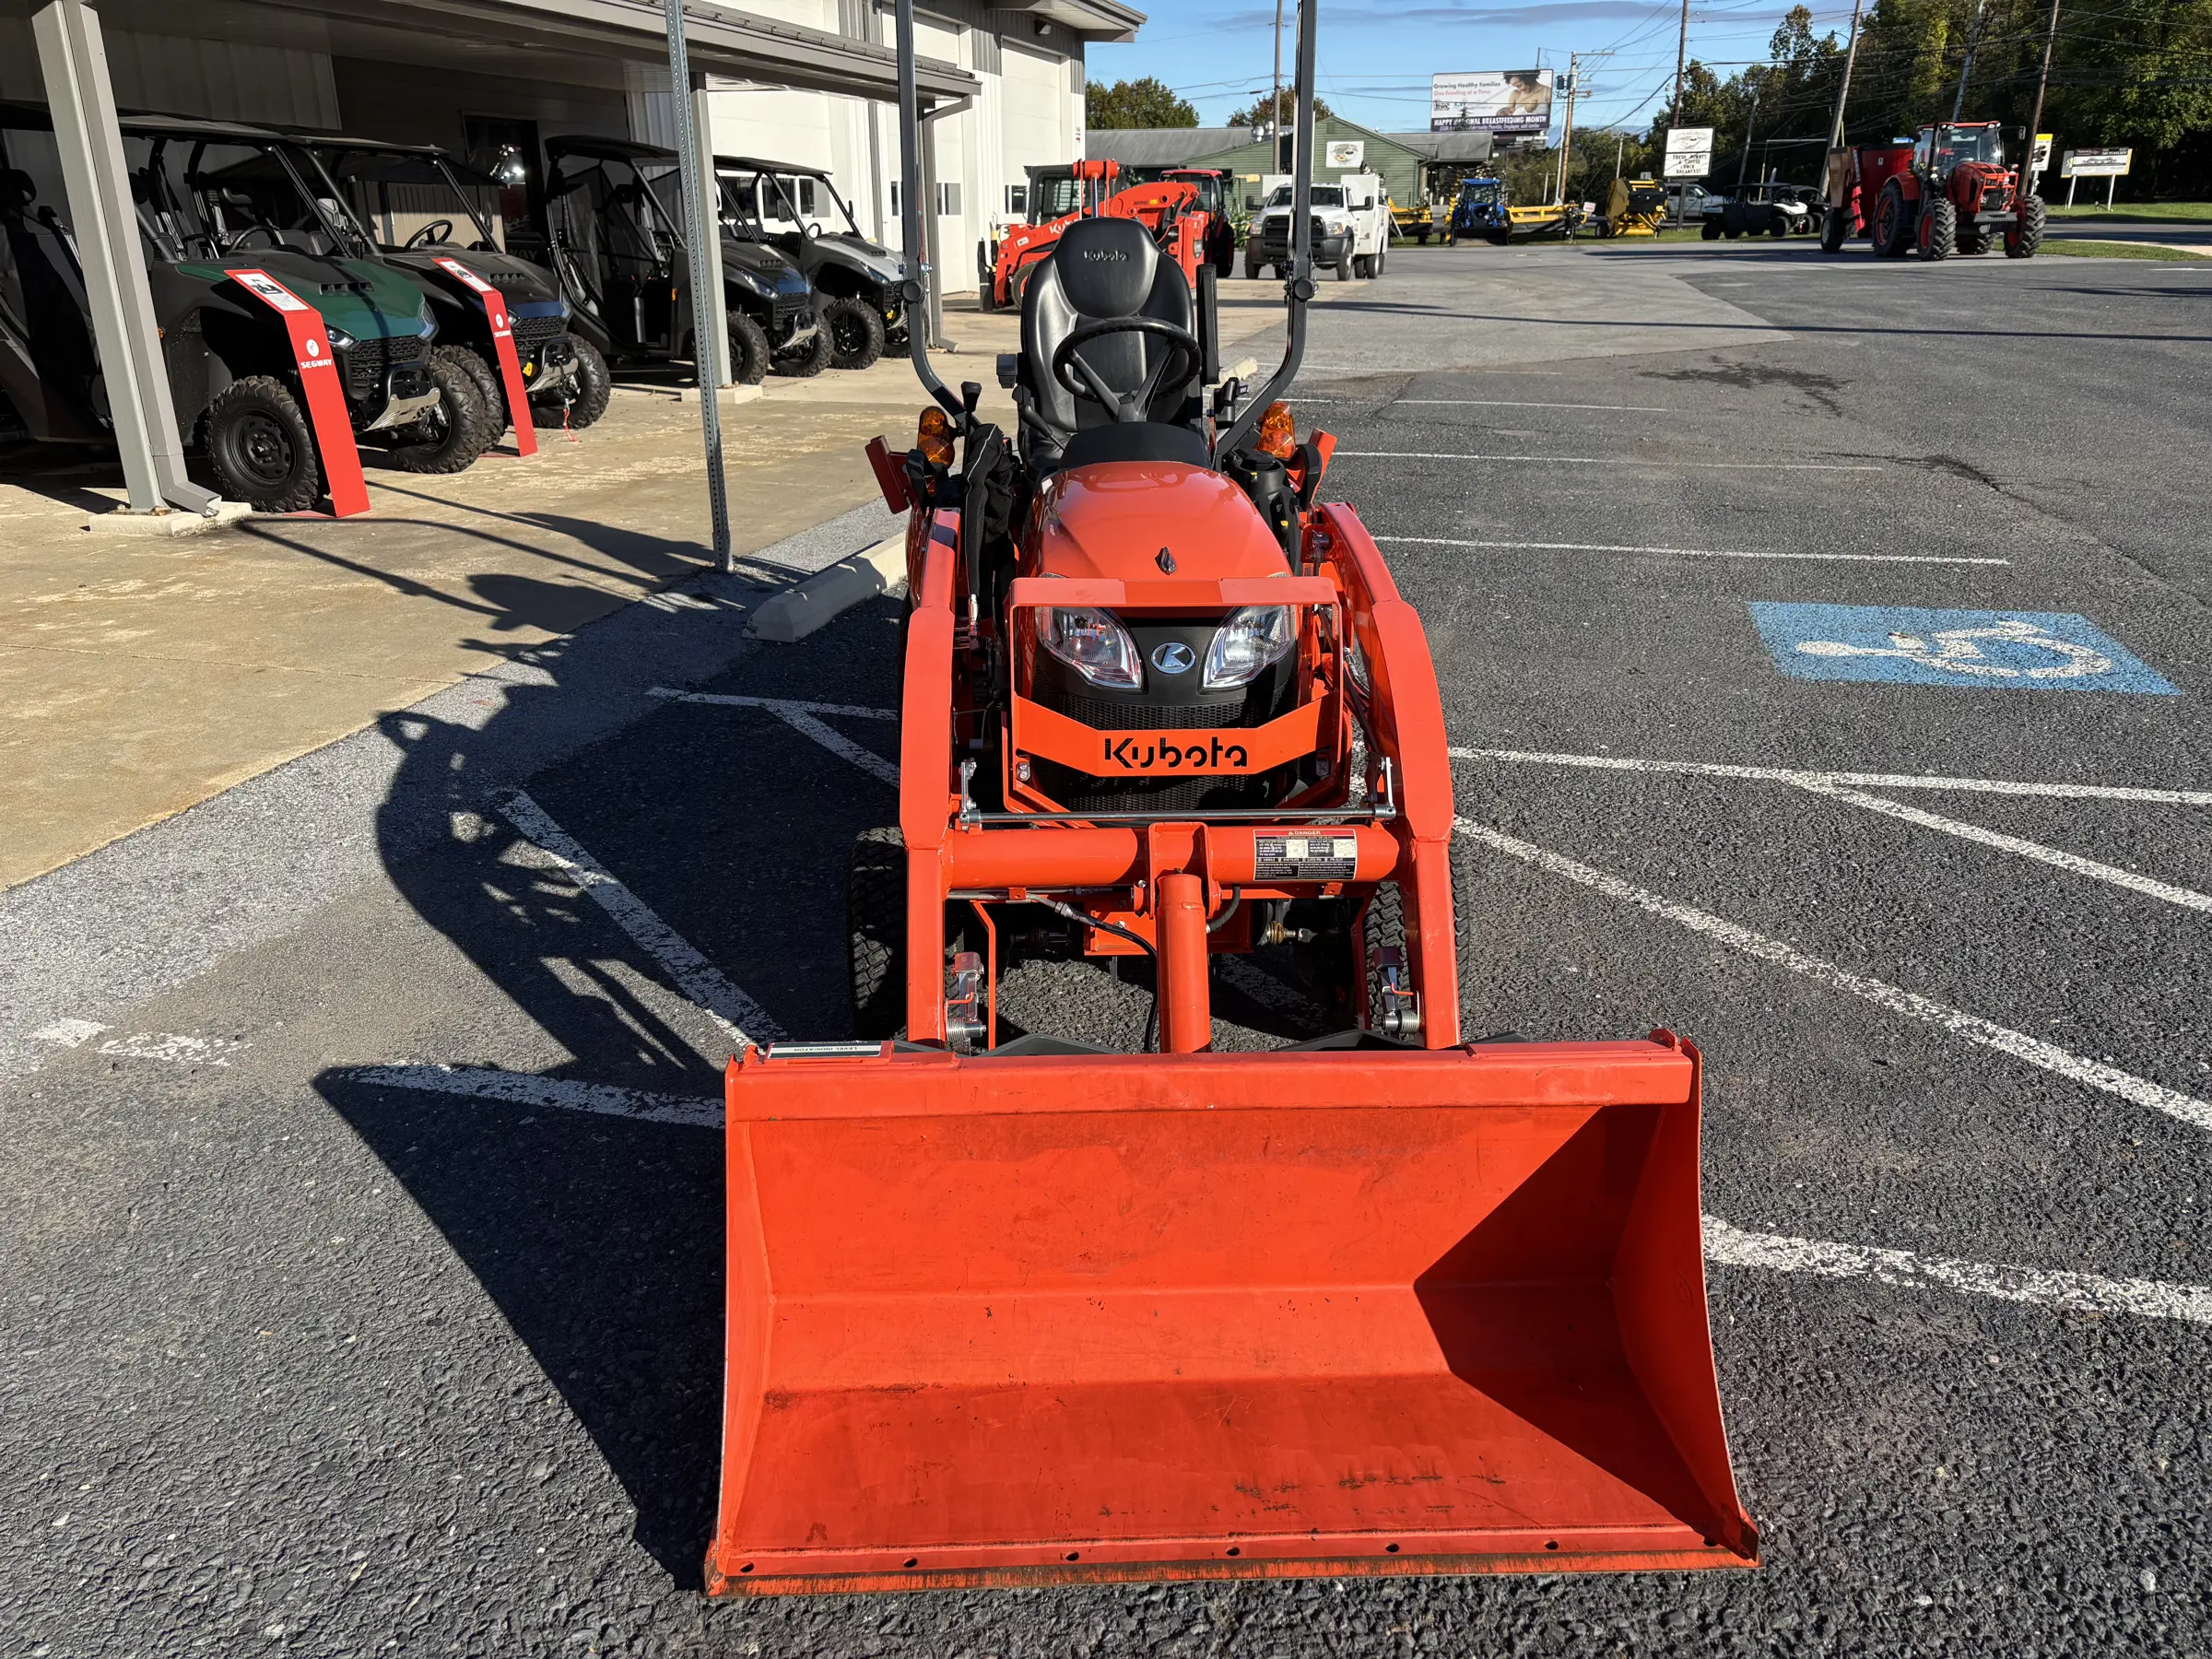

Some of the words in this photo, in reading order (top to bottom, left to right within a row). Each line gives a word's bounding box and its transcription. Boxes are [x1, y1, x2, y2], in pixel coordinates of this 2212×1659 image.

[1482, 116, 1524, 124] BREASTFEEDING
[1084, 249, 1128, 263] Kubota
[300, 359, 332, 369] SEGWAY
[1104, 736, 1248, 769] Kubota
